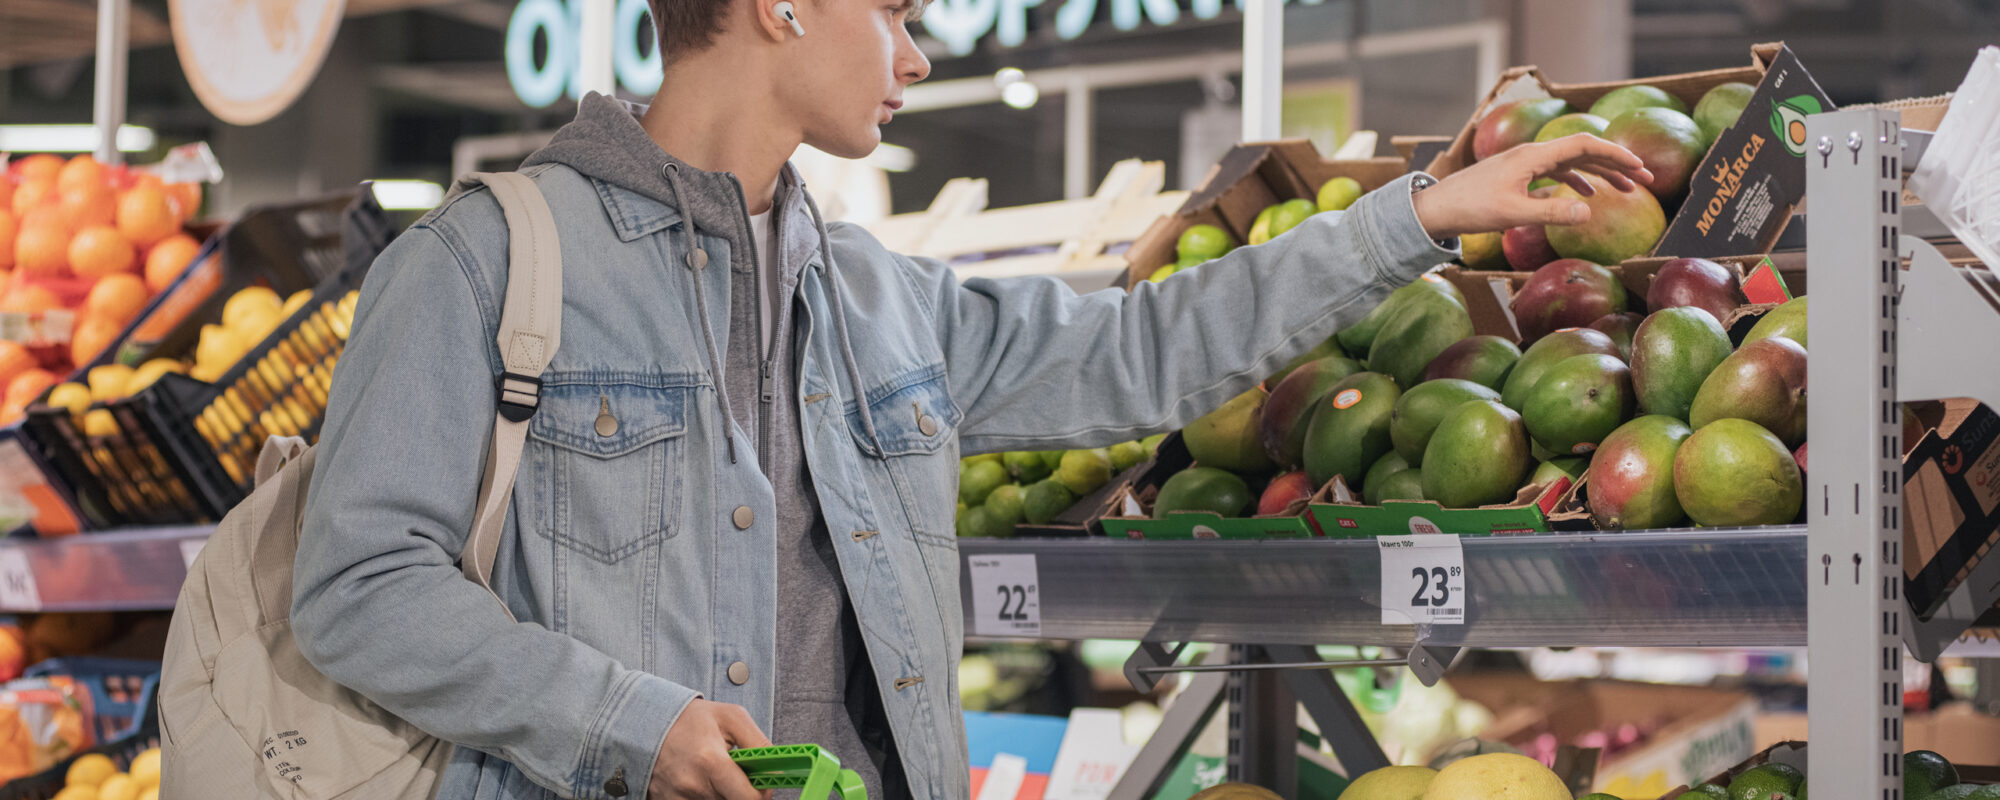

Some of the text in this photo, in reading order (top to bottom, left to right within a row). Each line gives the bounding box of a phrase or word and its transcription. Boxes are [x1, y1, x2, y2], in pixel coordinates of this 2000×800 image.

[1696, 133, 1766, 237] MONARCA
[997, 585, 1028, 620] 22
[1411, 566, 1461, 607] 23 89
[264, 737, 307, 759] WT. 2 KG
